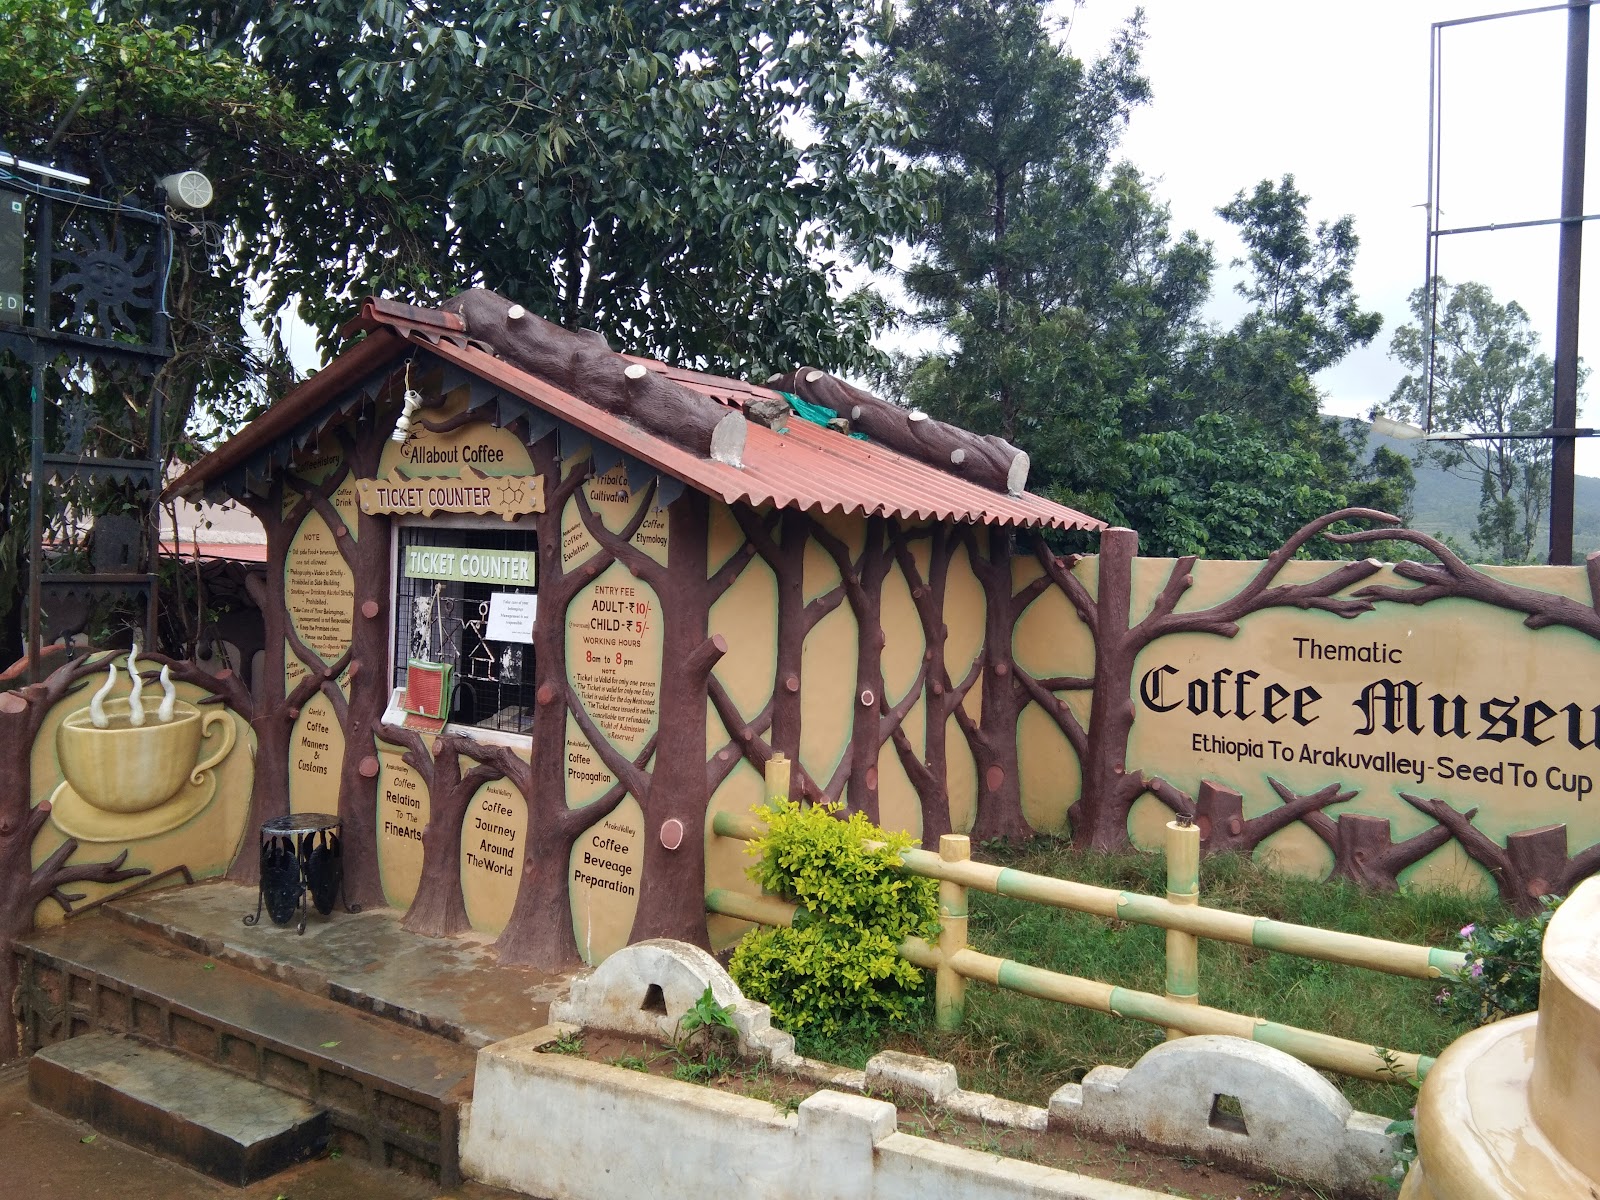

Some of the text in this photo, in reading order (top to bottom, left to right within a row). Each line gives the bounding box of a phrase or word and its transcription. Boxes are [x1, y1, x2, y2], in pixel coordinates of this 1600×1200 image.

[410, 445, 504, 464] Allabout Coffee
[336, 499, 352, 507] Drink
[377, 487, 491, 508] TICKET COUNTER
[643, 520, 665, 529] Coffee
[564, 532, 583, 548] Coffee
[636, 533, 668, 548] Etymology
[563, 542, 590, 562] Evolution
[410, 551, 530, 582] TICKET COUNTER
[595, 586, 635, 597] ENTRY FEE
[583, 636, 641, 648] WORKING HOURS
[1293, 637, 1403, 664] Thematic
[604, 656, 611, 664] to
[286, 668, 307, 680] Tradition
[577, 673, 593, 682] Ticket
[587, 684, 601, 692] Ticket
[642, 689, 655, 697] Entry
[1140, 664, 1323, 727] Coffee
[308, 707, 326, 717] World's
[306, 721, 329, 734] Coffee
[600, 721, 645, 733] Right of Admission
[301, 737, 329, 751] Manners
[314, 751, 320, 760] &
[568, 753, 591, 765] Coffee
[298, 759, 328, 775] Customs
[1192, 733, 1264, 762] Ethiopia
[1268, 741, 1294, 762] To
[1508, 762, 1538, 788] To
[1546, 766, 1593, 802] Cup
[394, 777, 416, 791] Coffee
[568, 768, 611, 785] Propagation
[386, 791, 421, 810] Relation
[396, 810, 418, 824] To The
[482, 801, 513, 817] Coffee
[385, 821, 422, 841] FineArts
[475, 818, 516, 841] Journey
[480, 839, 515, 859] Around
[592, 836, 629, 855] Coffee
[584, 852, 632, 877] Beveage
[574, 870, 635, 896] Preparation
